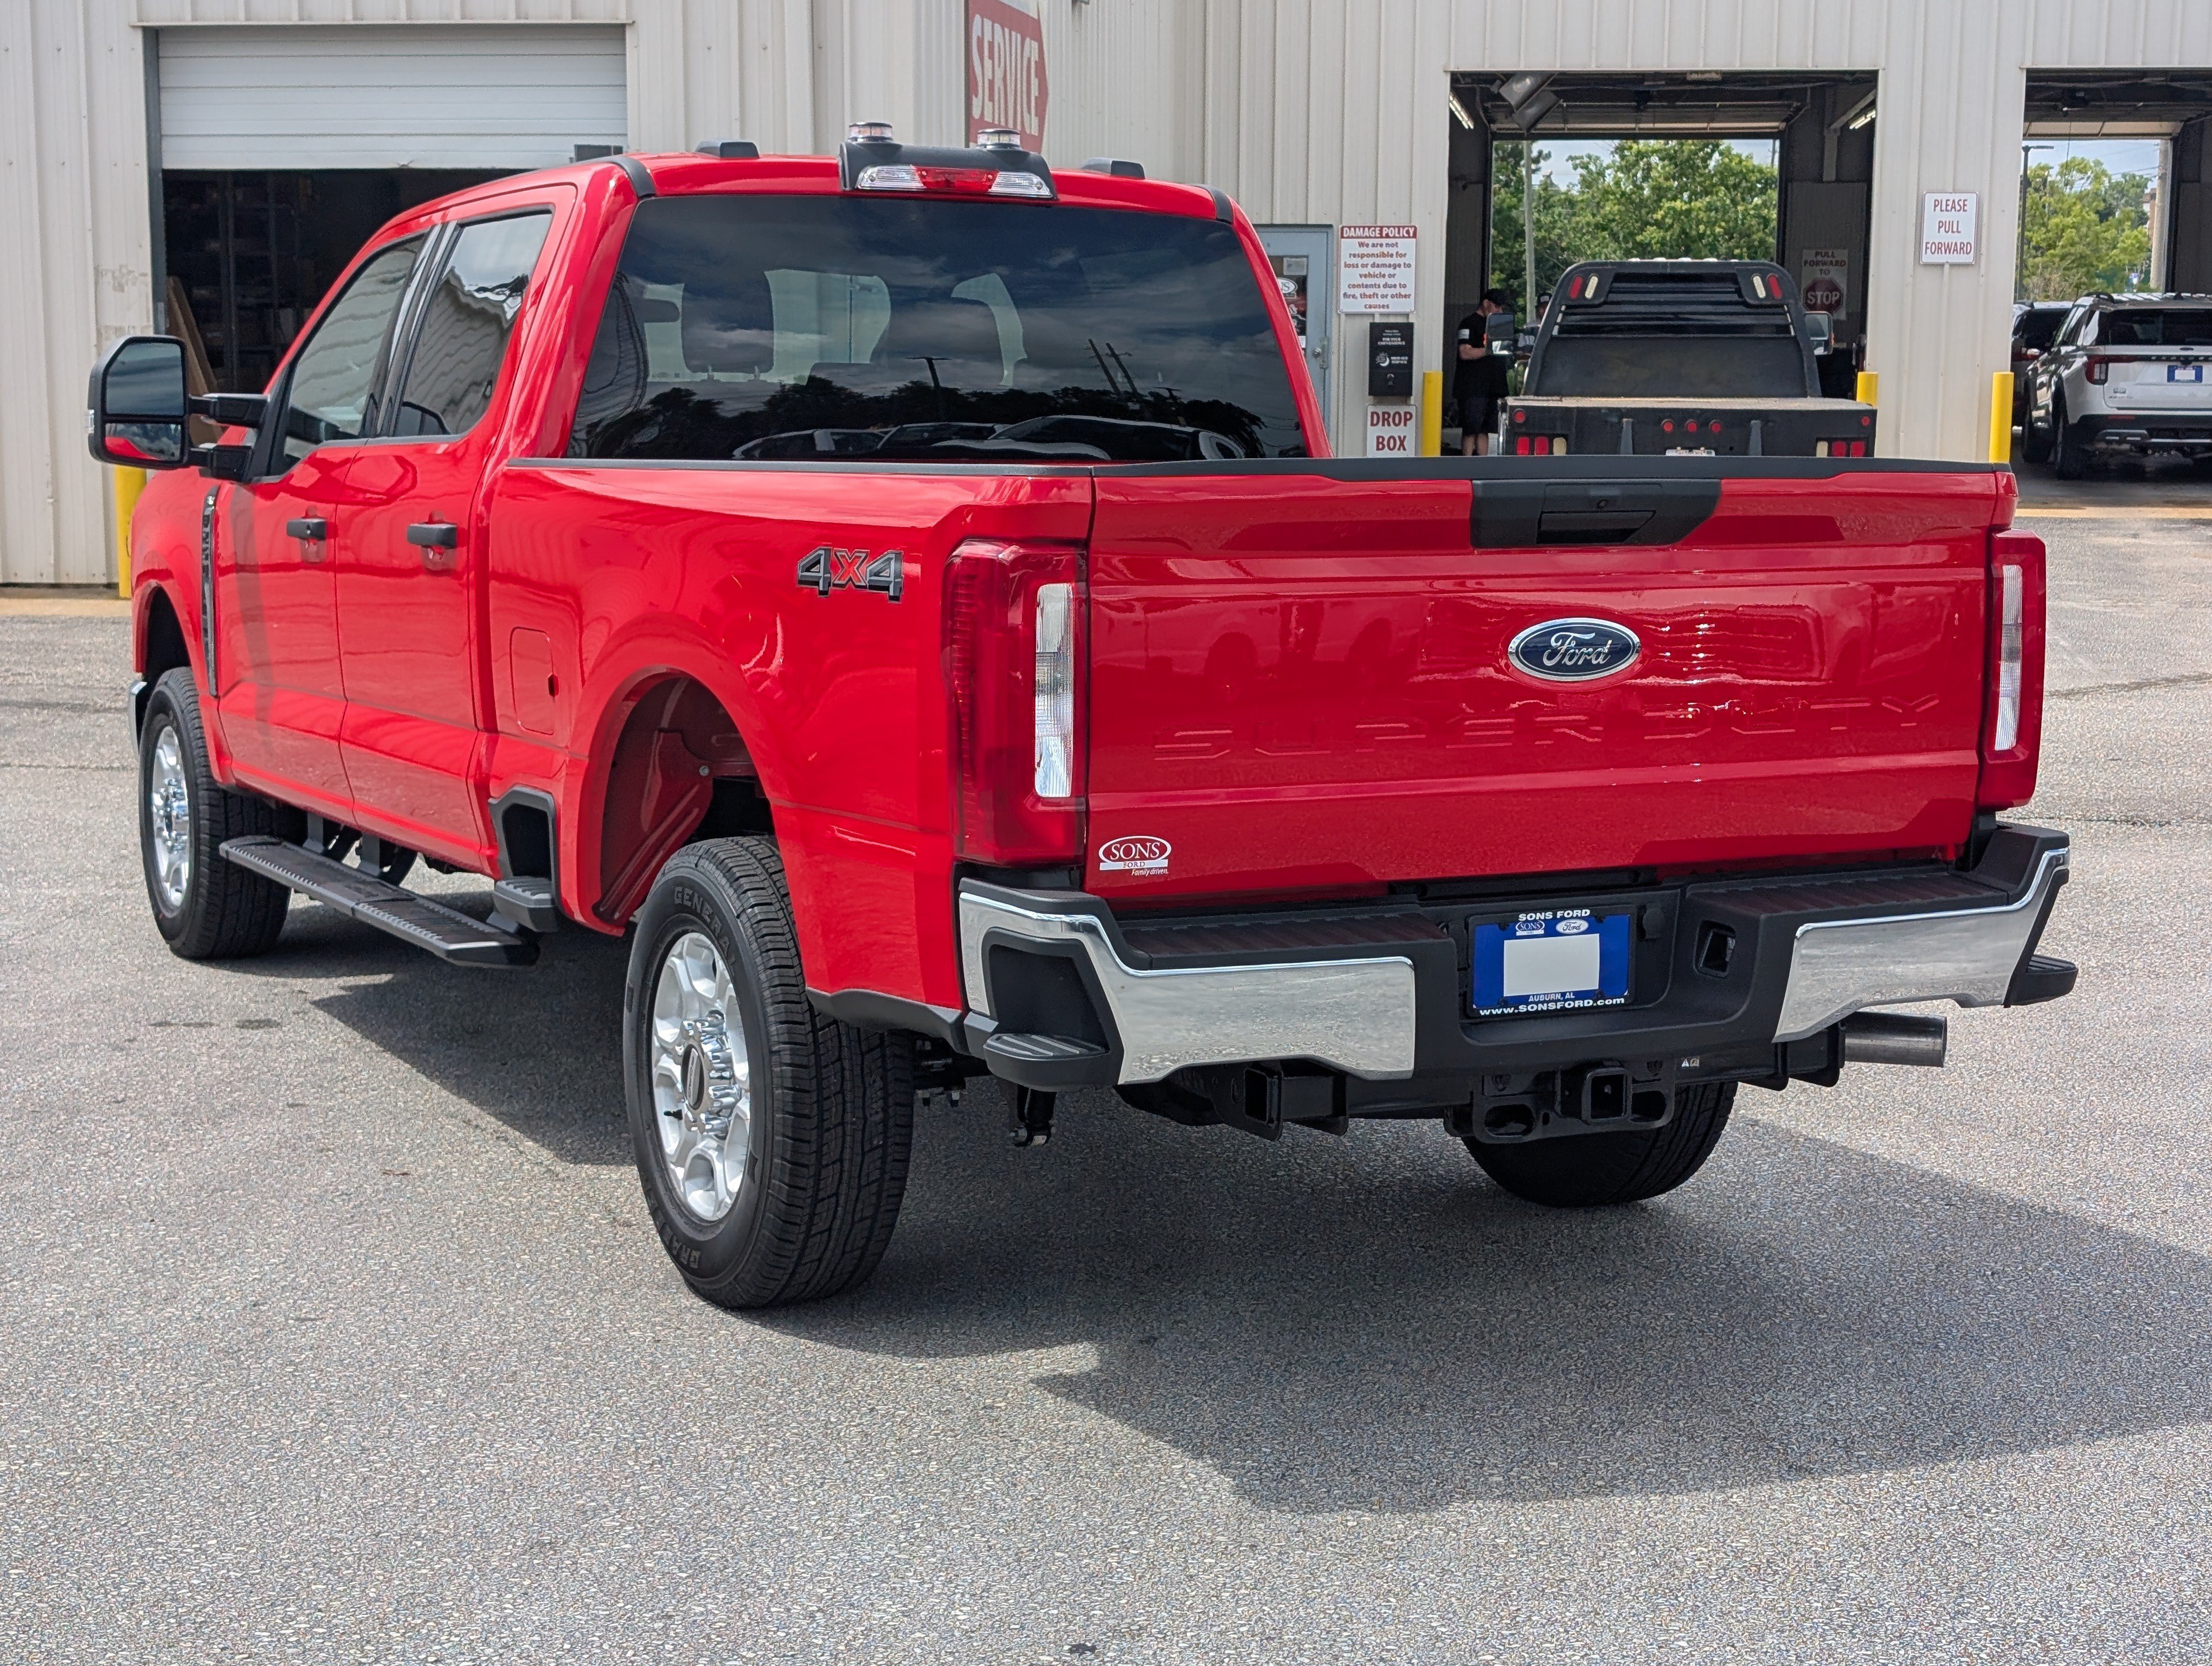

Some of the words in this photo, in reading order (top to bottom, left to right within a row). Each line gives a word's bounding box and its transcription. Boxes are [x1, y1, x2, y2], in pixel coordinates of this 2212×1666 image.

[972, 14, 1039, 136] SERVICE
[1933, 198, 1968, 213] PLEASE
[1343, 227, 1381, 238] DAMAGE
[1382, 226, 1414, 237] POLICY
[1937, 220, 1961, 234] PULL
[1924, 242, 1972, 255] FORWARD
[1348, 251, 1394, 260] responsible
[1370, 261, 1401, 270] damage
[1803, 260, 1846, 268] FORWARD
[1343, 292, 1358, 300] fire,
[1807, 291, 1840, 305] STOP
[1370, 411, 1413, 427] DROP
[1375, 435, 1407, 451] BOX
[1542, 632, 1613, 667] Ford
[1152, 712, 1603, 760] SUPER
[1643, 693, 1941, 740] DUTY
[1110, 842, 1161, 860] SONS
[1131, 868, 1150, 877] Family
[1518, 912, 1553, 921] SONS
[1557, 909, 1590, 919] FORD
[1520, 922, 1541, 931] SONS
[1562, 921, 1583, 931] Ford
[1528, 993, 1564, 1002] AUBURN,
[1479, 997, 1625, 1016] www.SONSFORD.com
